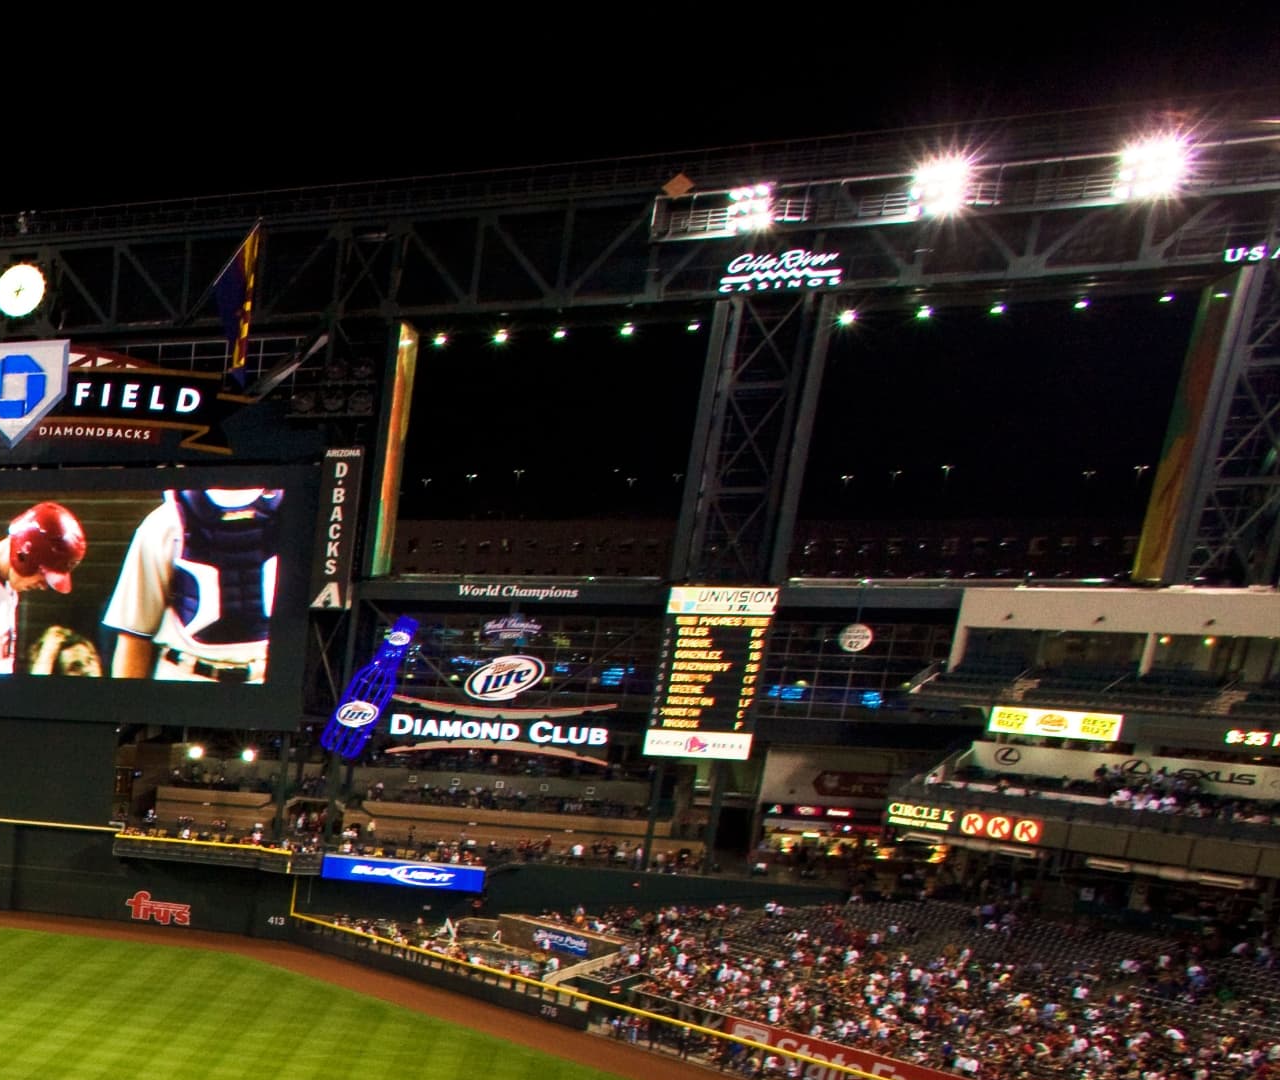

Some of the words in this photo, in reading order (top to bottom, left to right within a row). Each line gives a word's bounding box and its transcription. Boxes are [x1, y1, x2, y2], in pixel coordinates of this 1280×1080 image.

[727, 252, 779, 274] Gila
[776, 249, 840, 270] River
[719, 277, 841, 293] CASINOS
[73, 381, 203, 413] FIELD
[38, 426, 153, 441] DIAMONDBACKS
[325, 450, 361, 458] ARIZONA
[458, 584, 502, 597] World
[501, 585, 579, 601] Champions
[698, 590, 779, 603] UNIVISION
[699, 616, 744, 626] PADRES
[677, 627, 711, 636] GILES
[738, 698, 754, 708] LF
[997, 710, 1029, 722] BEST
[1081, 716, 1118, 729] BEST
[390, 713, 520, 741] DIAMOND
[528, 721, 609, 746] CLUB
[996, 719, 1024, 730] BUY
[1081, 725, 1112, 737] BUY
[1158, 766, 1257, 786] LEXUS
[887, 802, 941, 821] CIRCLE
[942, 810, 955, 823] K
[350, 864, 392, 876] BUD
[397, 868, 456, 882] LIGHT
[267, 916, 285, 926] 413
